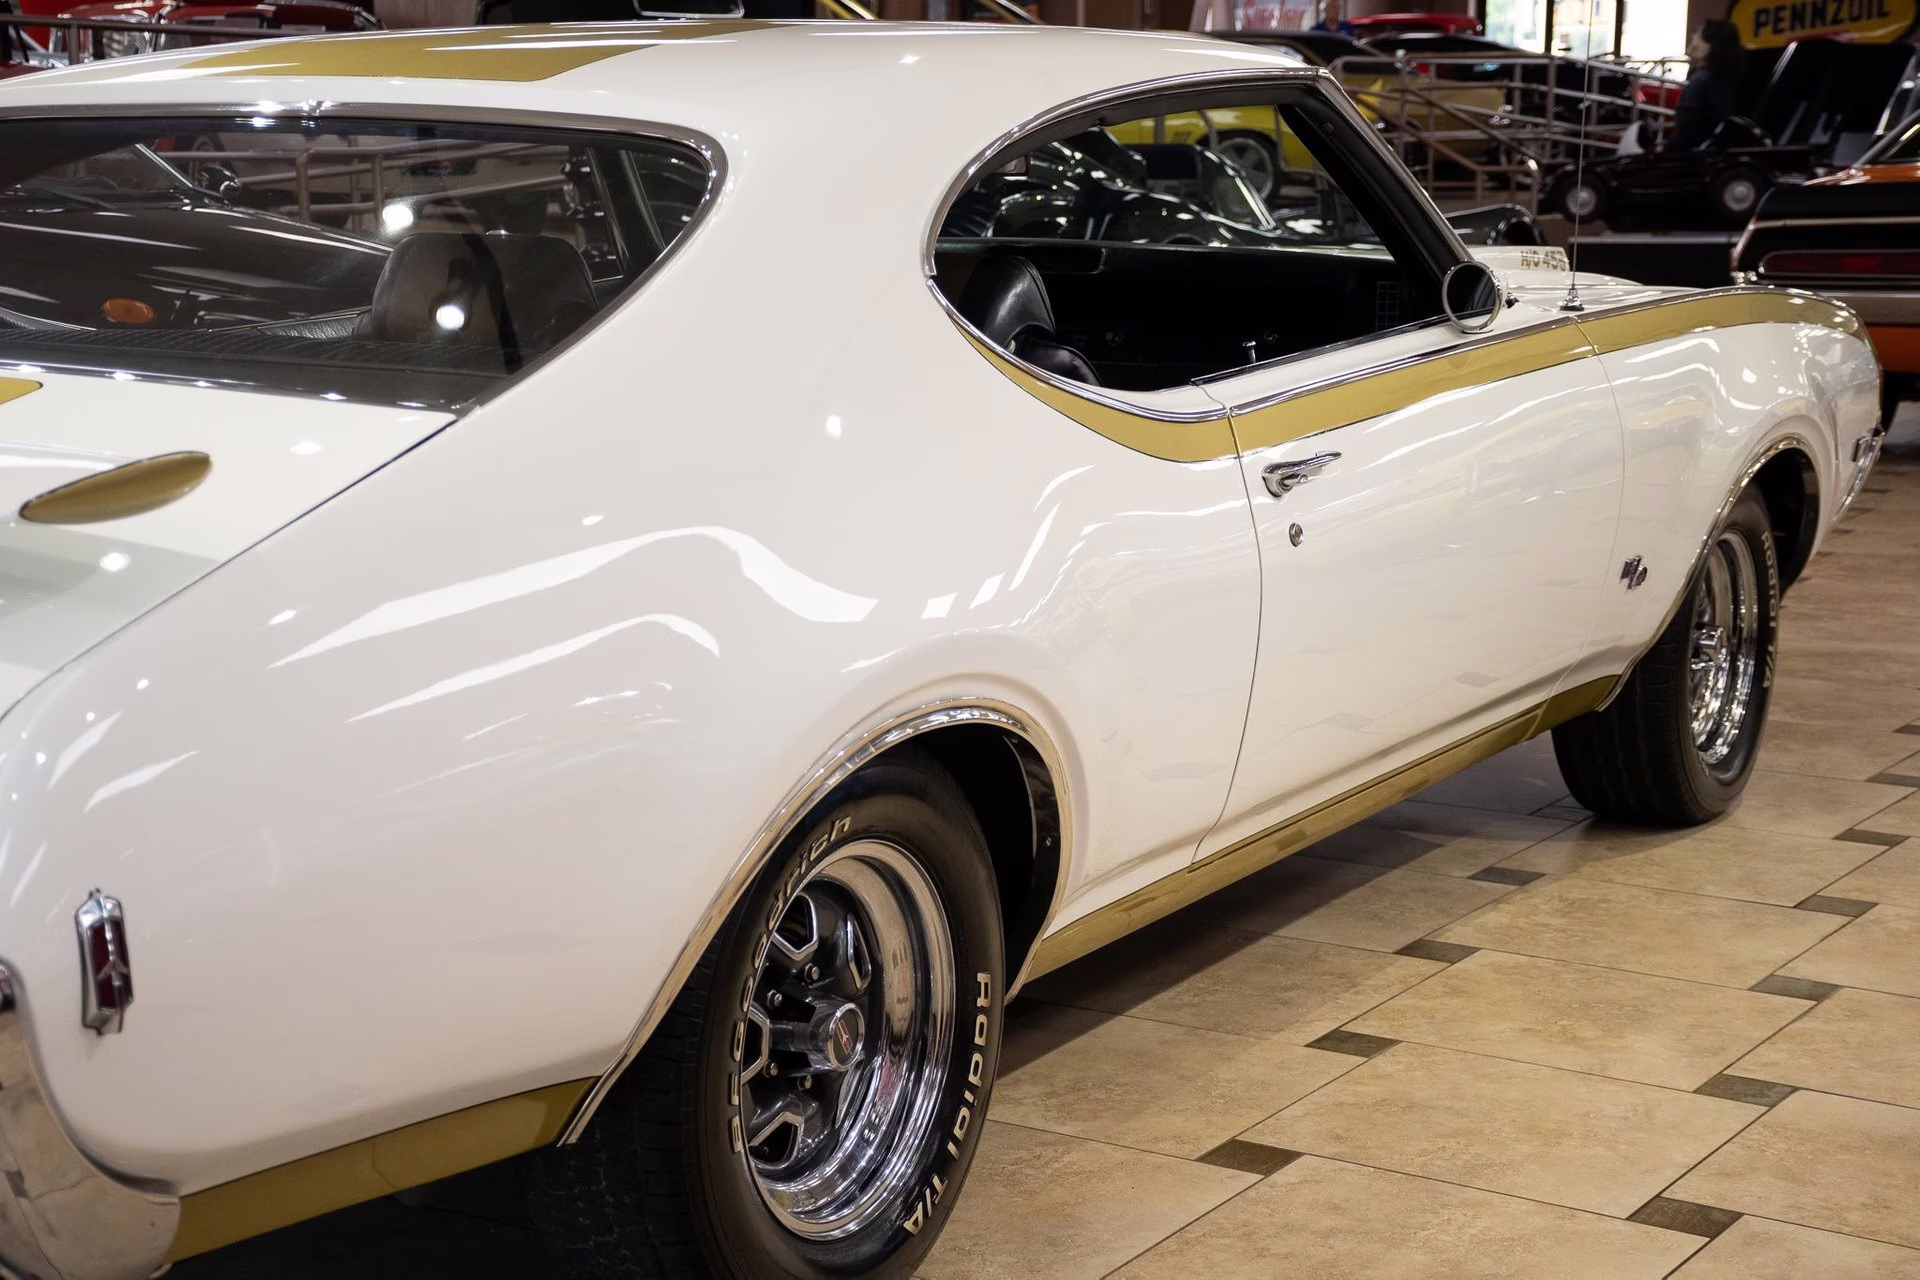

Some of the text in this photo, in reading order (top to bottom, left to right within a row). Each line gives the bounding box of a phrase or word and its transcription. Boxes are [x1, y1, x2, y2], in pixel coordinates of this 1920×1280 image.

[1754, 0, 1890, 38] PENNZOIL
[1761, 531, 1777, 628] Radial
[903, 972, 991, 1235] Radial T/A
